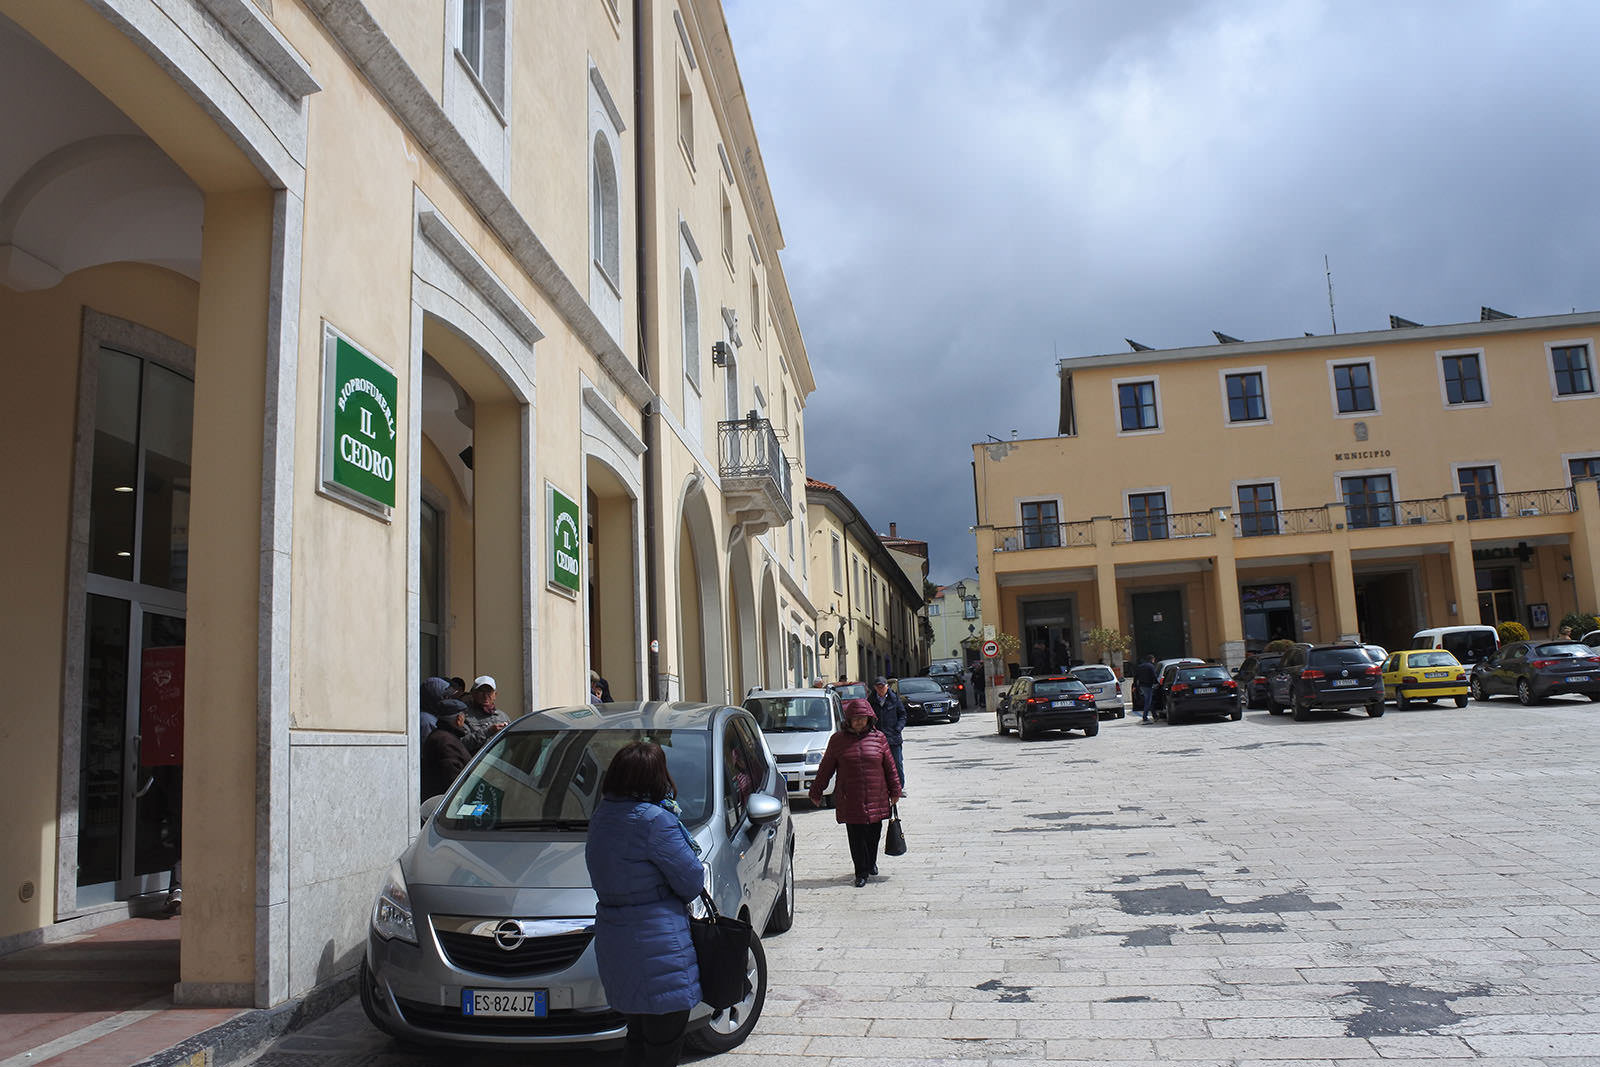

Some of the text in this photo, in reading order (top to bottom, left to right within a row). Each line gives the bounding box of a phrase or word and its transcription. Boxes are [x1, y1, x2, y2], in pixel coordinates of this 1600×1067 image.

[338, 378, 396, 440] BIOPROFUMERIA
[360, 407, 376, 440] IL
[340, 433, 393, 482] CEDRO
[1335, 449, 1391, 461] MUNICIPIO
[563, 530, 571, 550] IL
[557, 549, 579, 576] CEDRO
